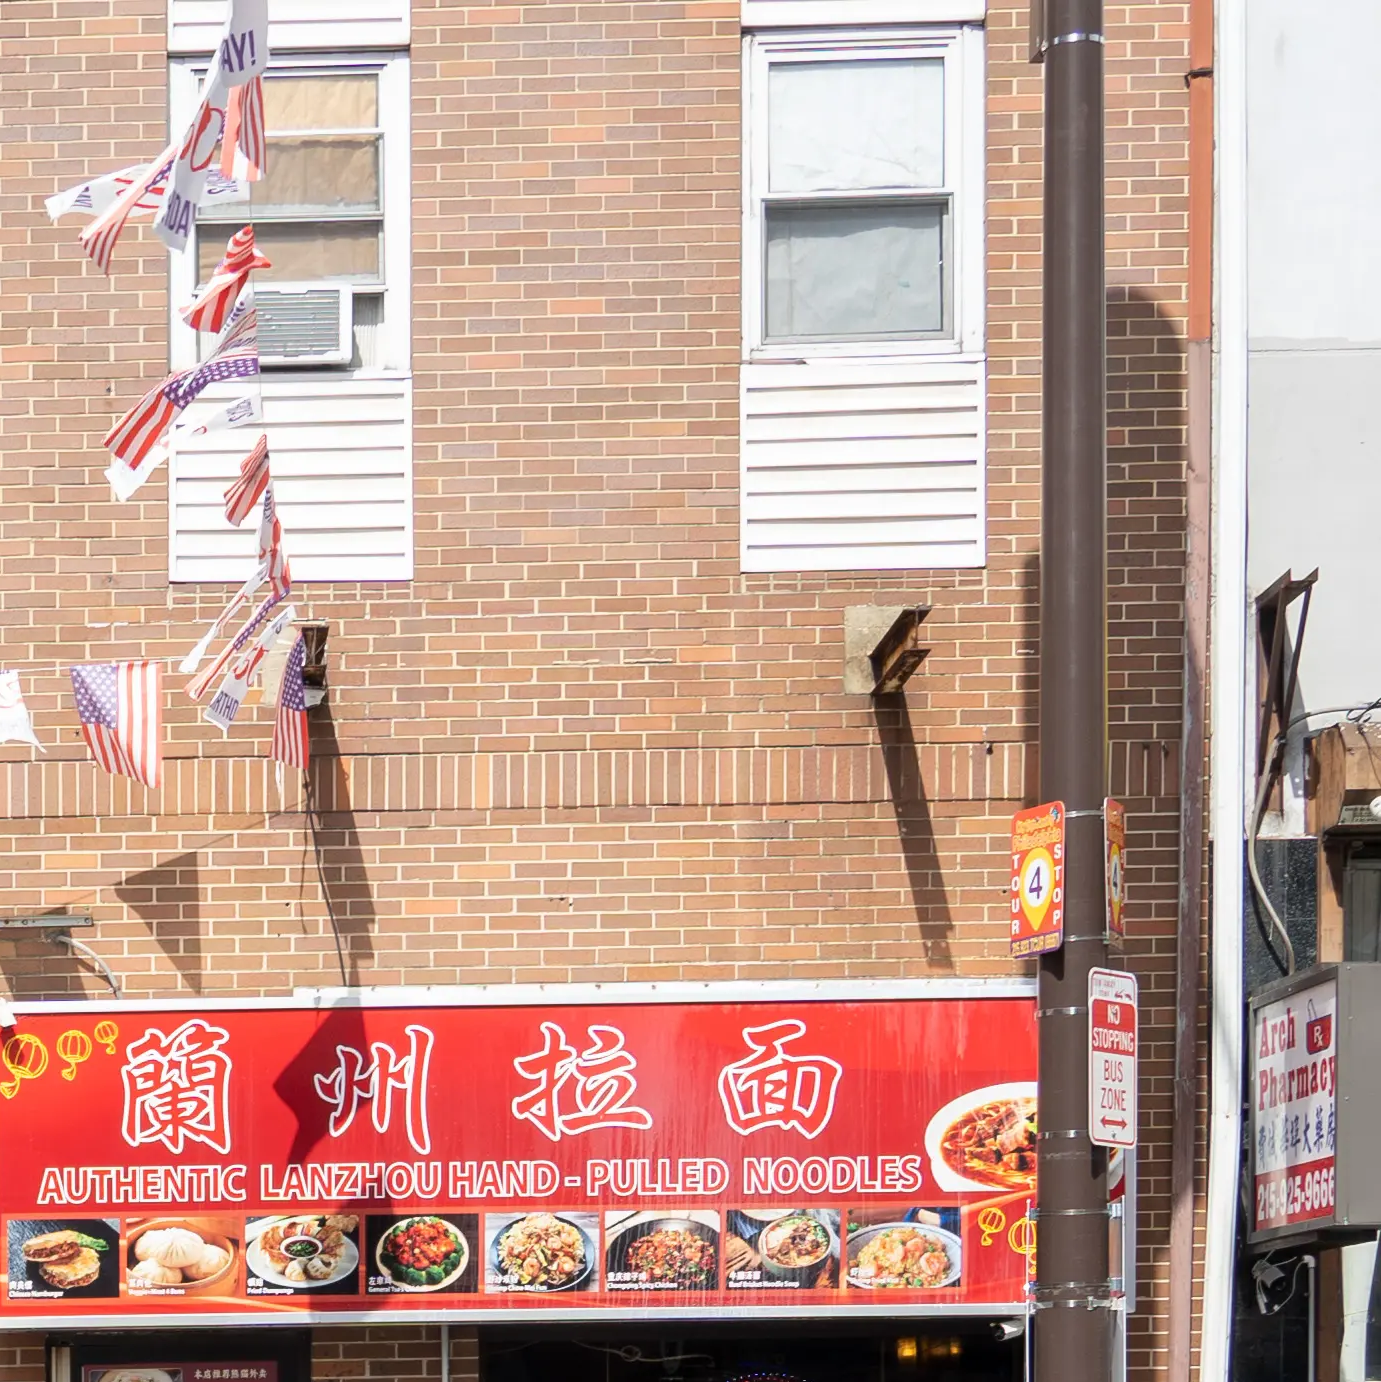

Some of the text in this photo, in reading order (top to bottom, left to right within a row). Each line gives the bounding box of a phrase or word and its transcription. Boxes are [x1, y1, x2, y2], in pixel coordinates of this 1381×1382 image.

[1028, 866, 1043, 900] 4
[1107, 1003, 1121, 1025] NO
[1259, 1007, 1297, 1059] Arch
[1093, 1027, 1134, 1052] STOPPING
[120, 1018, 843, 1155] 蘭州拉面
[1103, 1060, 1123, 1083] BUS
[1258, 1055, 1336, 1112] Pharmacy
[1100, 1087, 1127, 1111] ZONE
[37, 1164, 247, 1206] AUTHENTIC
[259, 1161, 442, 1201] LANZHOU
[743, 1155, 922, 1197] NOODLES
[1257, 1167, 1335, 1222] 215-925-9666
